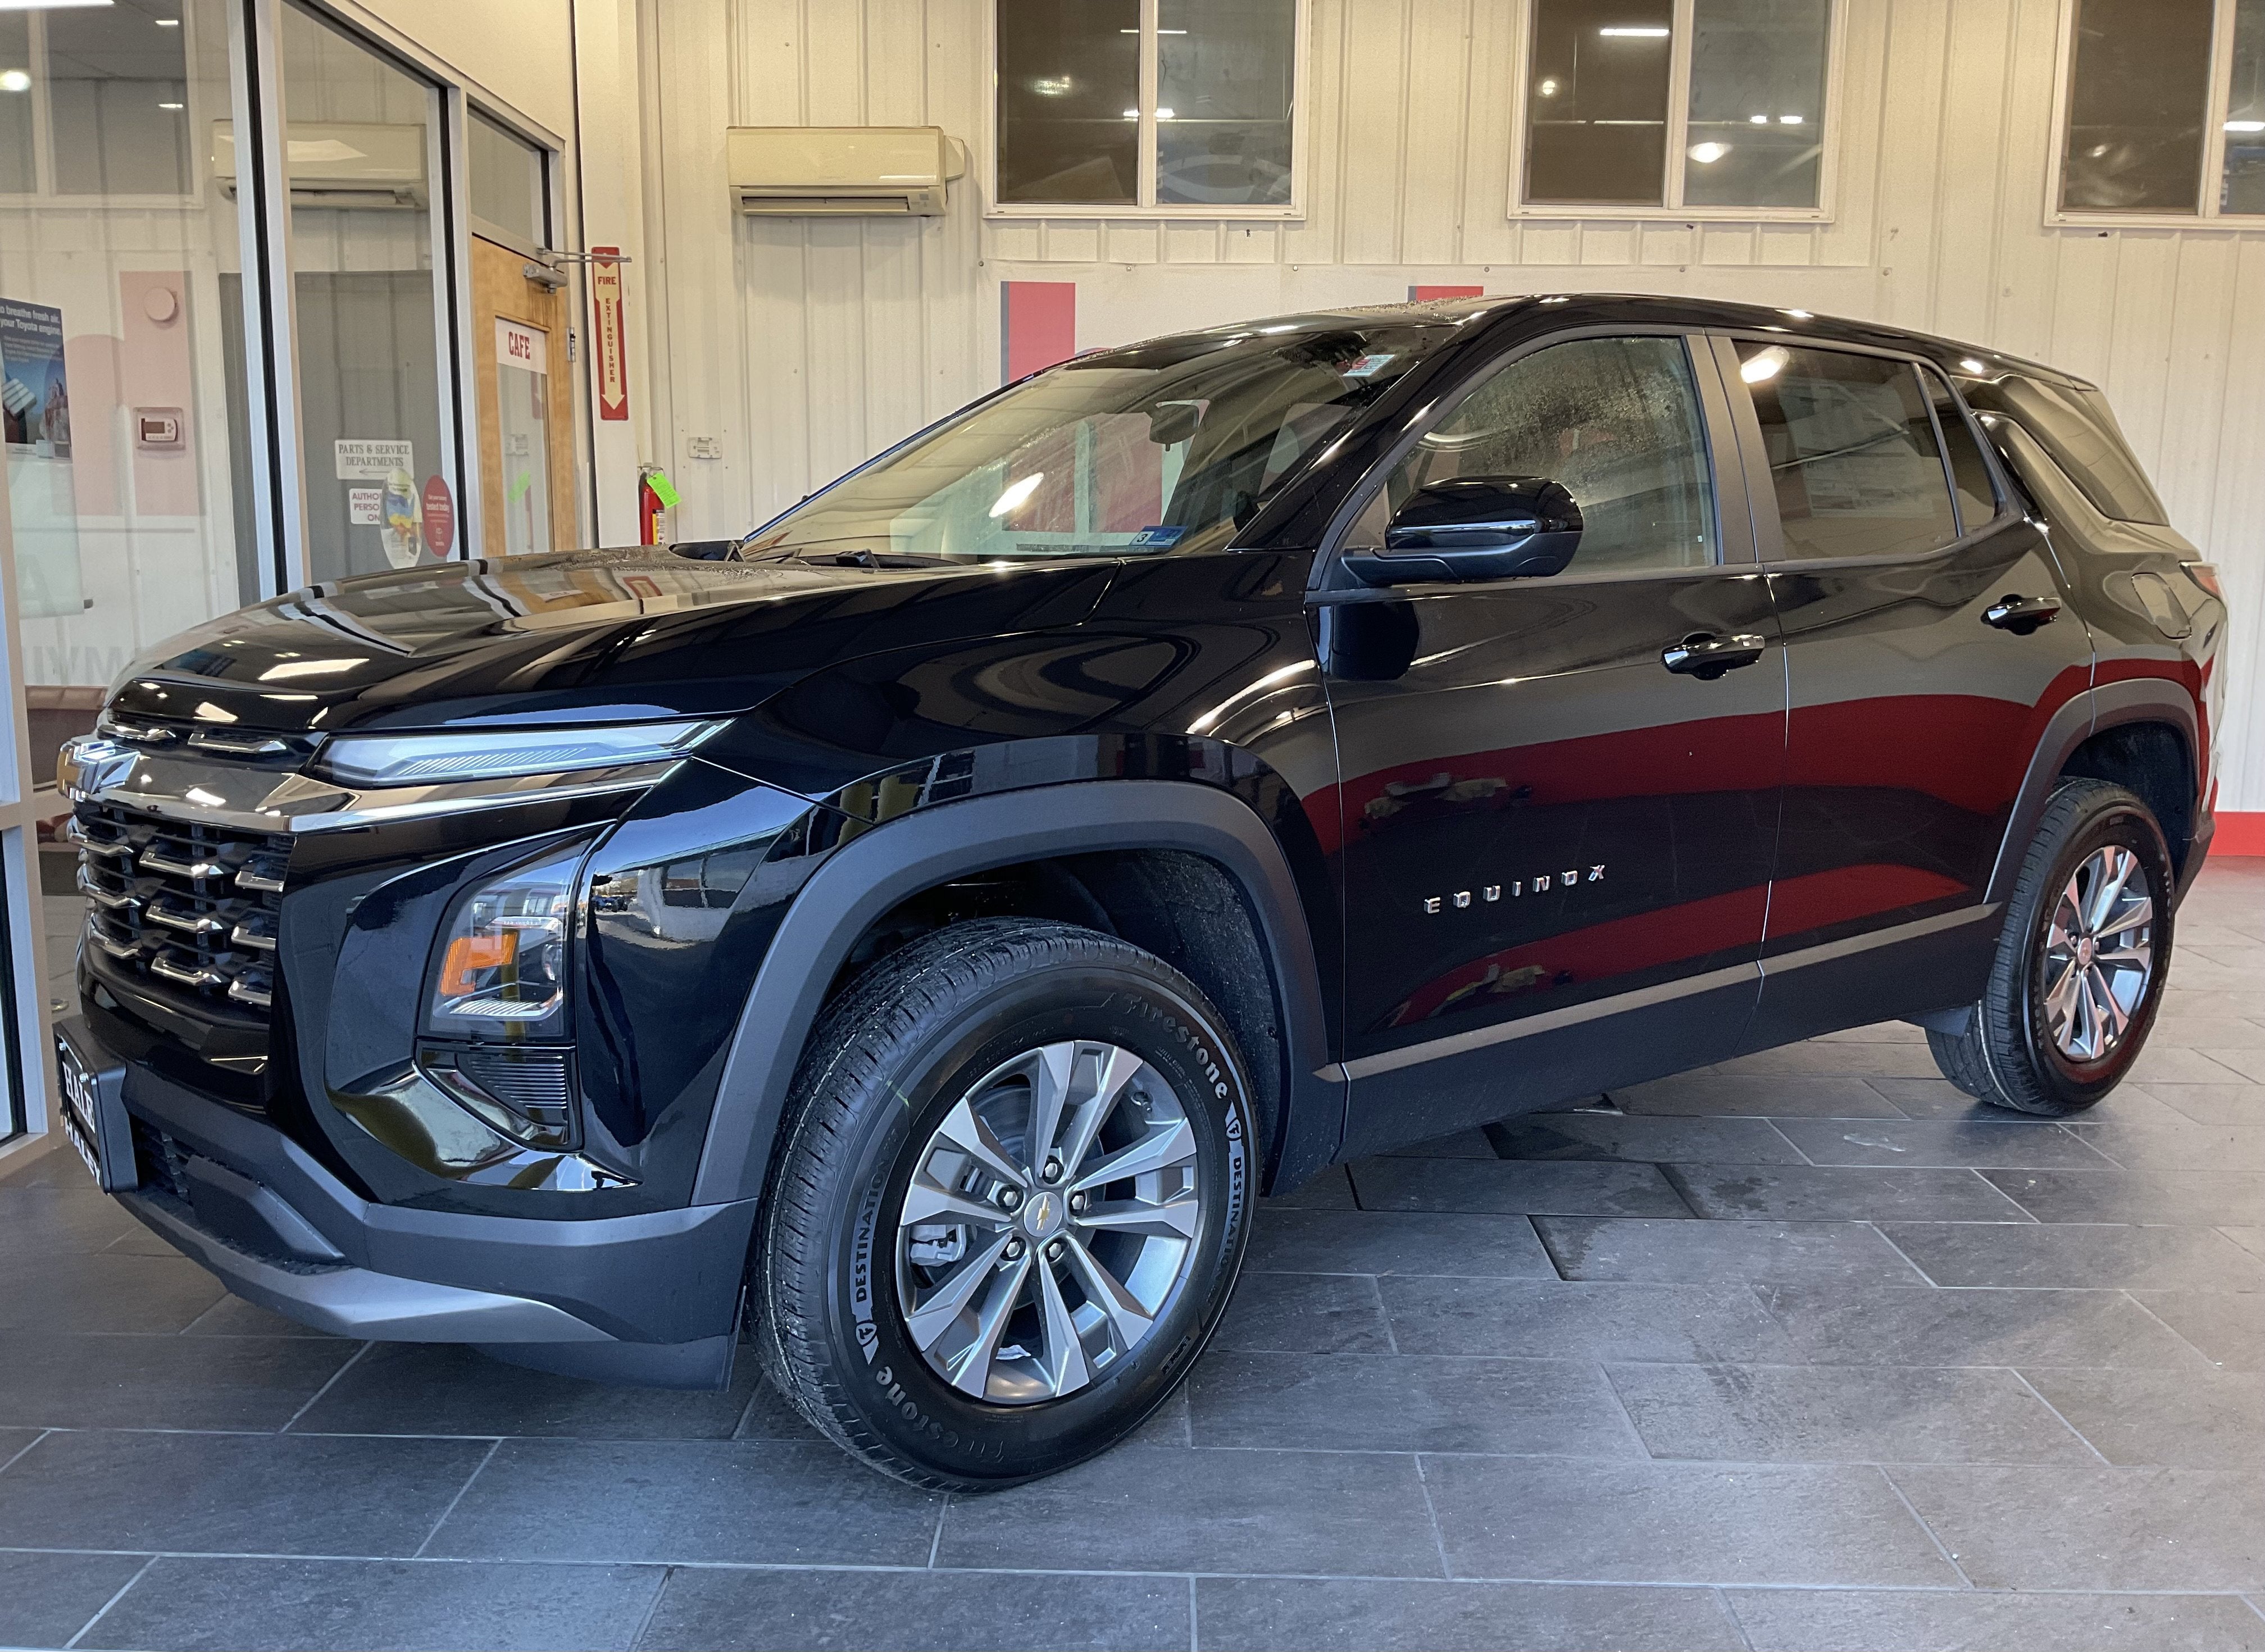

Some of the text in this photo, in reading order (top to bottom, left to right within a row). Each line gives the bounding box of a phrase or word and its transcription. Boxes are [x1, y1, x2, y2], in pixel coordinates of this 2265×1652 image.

[598, 276, 616, 285] FIRE
[6, 305, 32, 318] breathe
[33, 310, 49, 321] fresh
[1, 318, 15, 328] your
[16, 319, 38, 331] Toyota
[508, 331, 530, 359] CAFE
[606, 298, 615, 382] EXTINGUISHER
[338, 444, 410, 454] PARTS & SERVICE
[346, 457, 404, 466] DEPARTMENTS
[1136, 534, 1148, 543] 3
[1424, 865, 1605, 914] EQUINOX
[1124, 993, 1228, 1099] Firestone
[1213, 1156, 1242, 1280] DESTINATION
